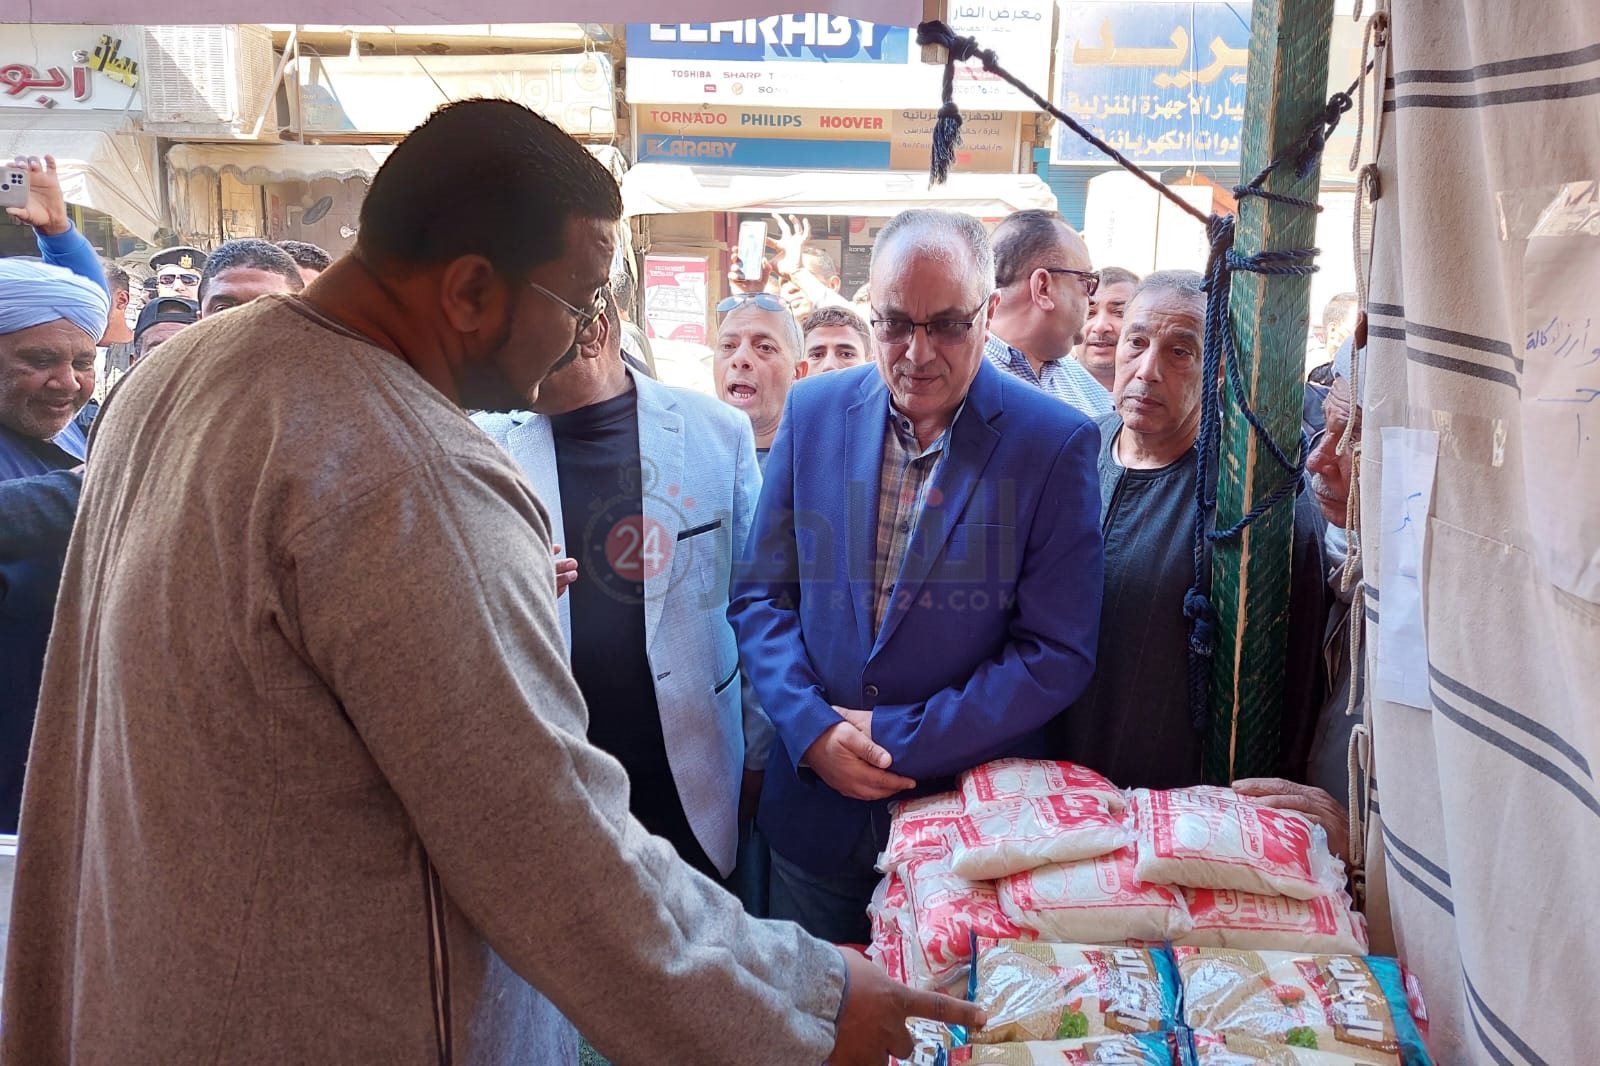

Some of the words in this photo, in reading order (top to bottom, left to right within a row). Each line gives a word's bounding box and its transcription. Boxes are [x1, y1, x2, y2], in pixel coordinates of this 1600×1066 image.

[671, 69, 712, 79] TOSHIBA
[723, 71, 762, 79] SHARP
[650, 110, 728, 125] TORNADO
[741, 113, 802, 127] PHILIPS
[820, 116, 883, 129] HOOVER
[646, 139, 737, 159] ELARABY
